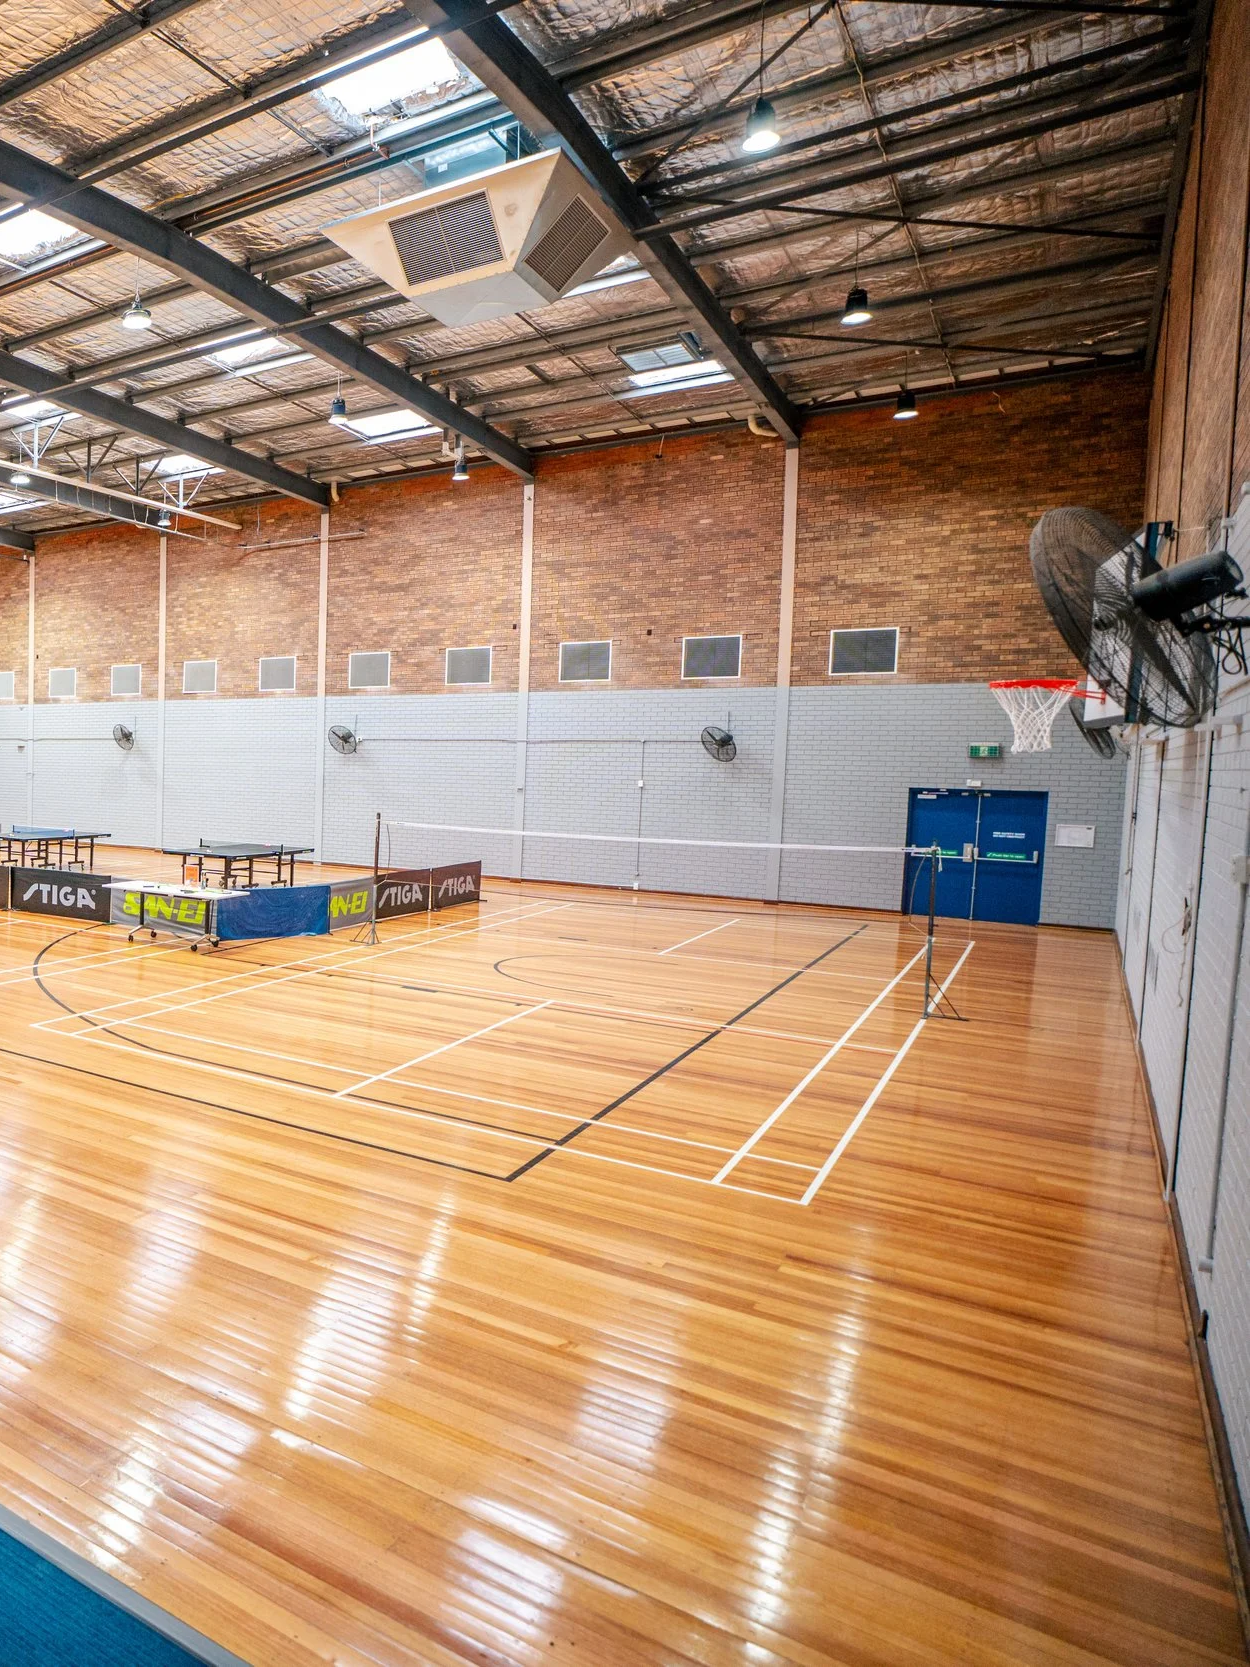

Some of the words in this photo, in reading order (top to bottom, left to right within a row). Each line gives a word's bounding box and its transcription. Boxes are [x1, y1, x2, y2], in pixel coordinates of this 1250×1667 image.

[23, 883, 96, 910] STIGA
[378, 883, 423, 908] STIGA
[438, 875, 475, 898] STIGA
[123, 892, 206, 924] SAN-EI
[328, 890, 368, 918] AN-EI
